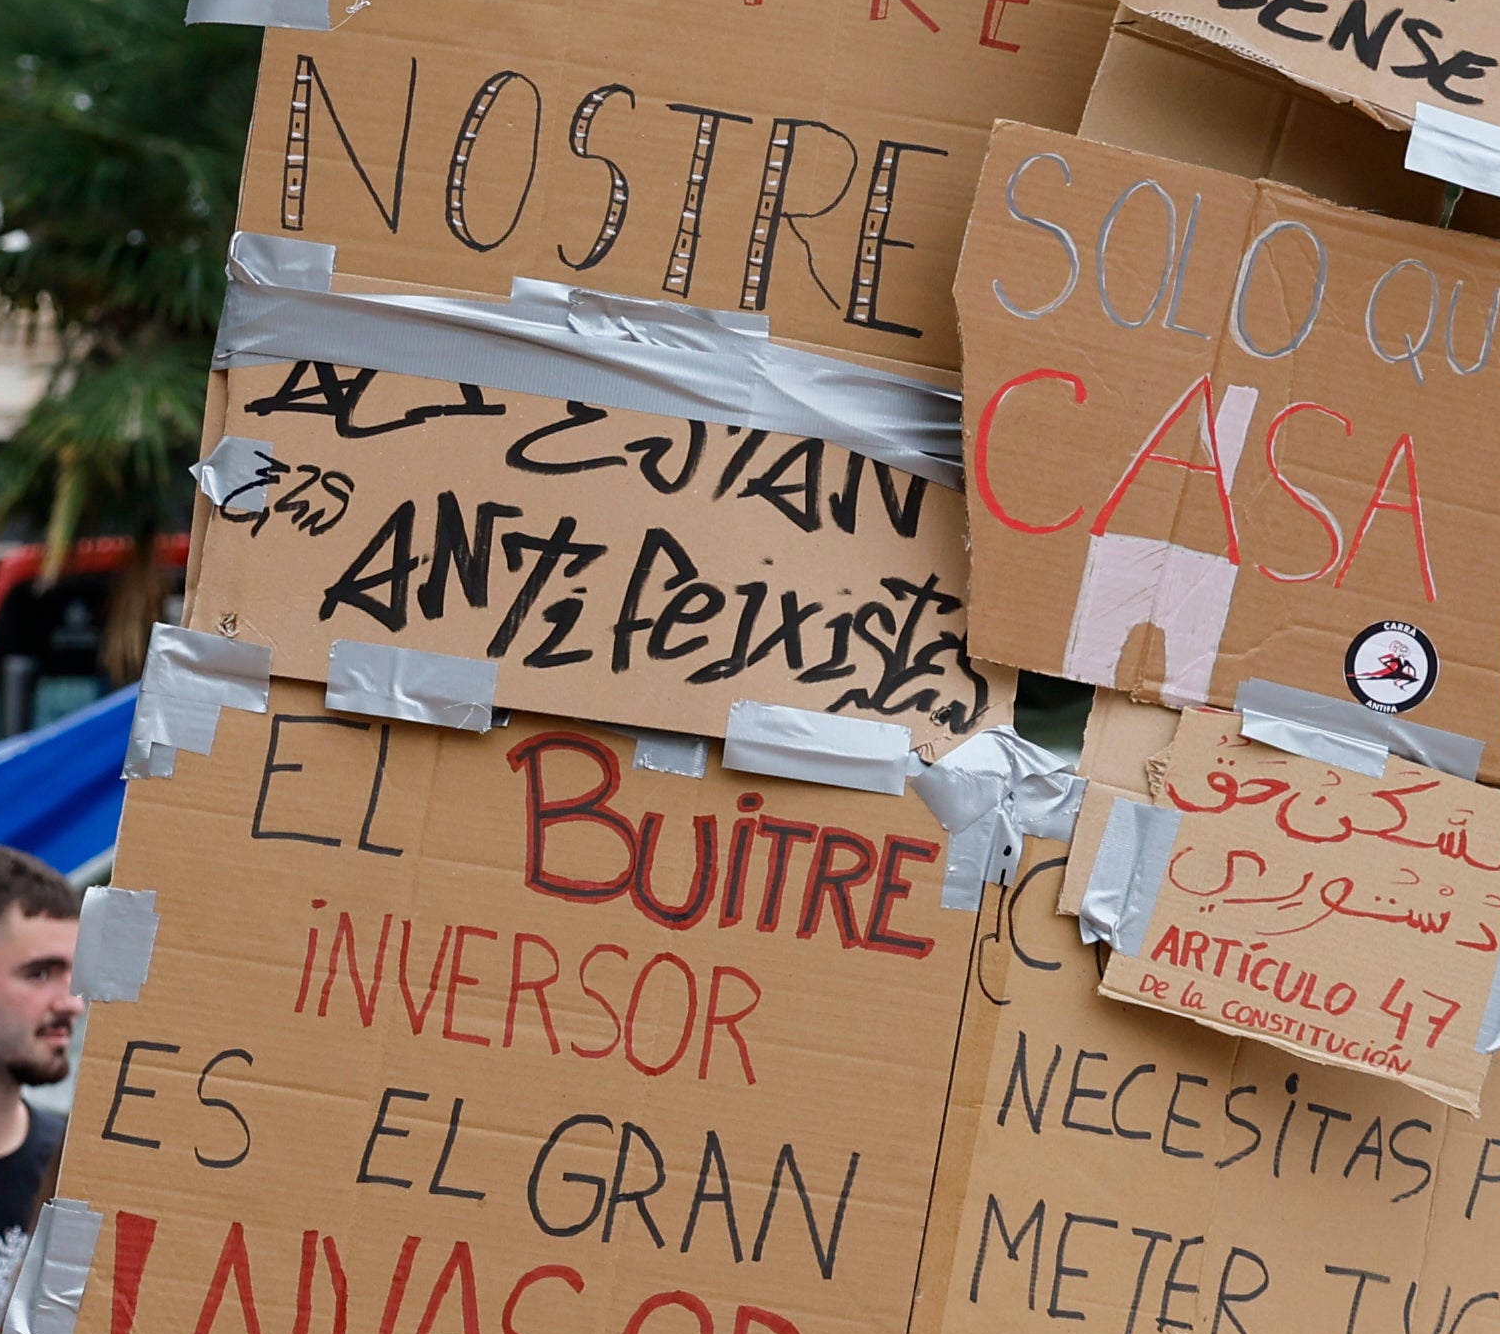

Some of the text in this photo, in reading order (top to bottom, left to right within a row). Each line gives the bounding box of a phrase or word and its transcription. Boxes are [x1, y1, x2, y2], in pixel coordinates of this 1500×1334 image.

[281, 53, 948, 339] NOSTRE
[991, 152, 1328, 361] SOLO
[973, 366, 1438, 605] CASA
[250, 714, 404, 856] EL
[1366, 700, 1398, 713] ANTIFA
[1150, 925, 1358, 1016] ARTÍCULO
[1380, 977, 1461, 1049] 47
[101, 1041, 862, 1281] ES EL GRAN
